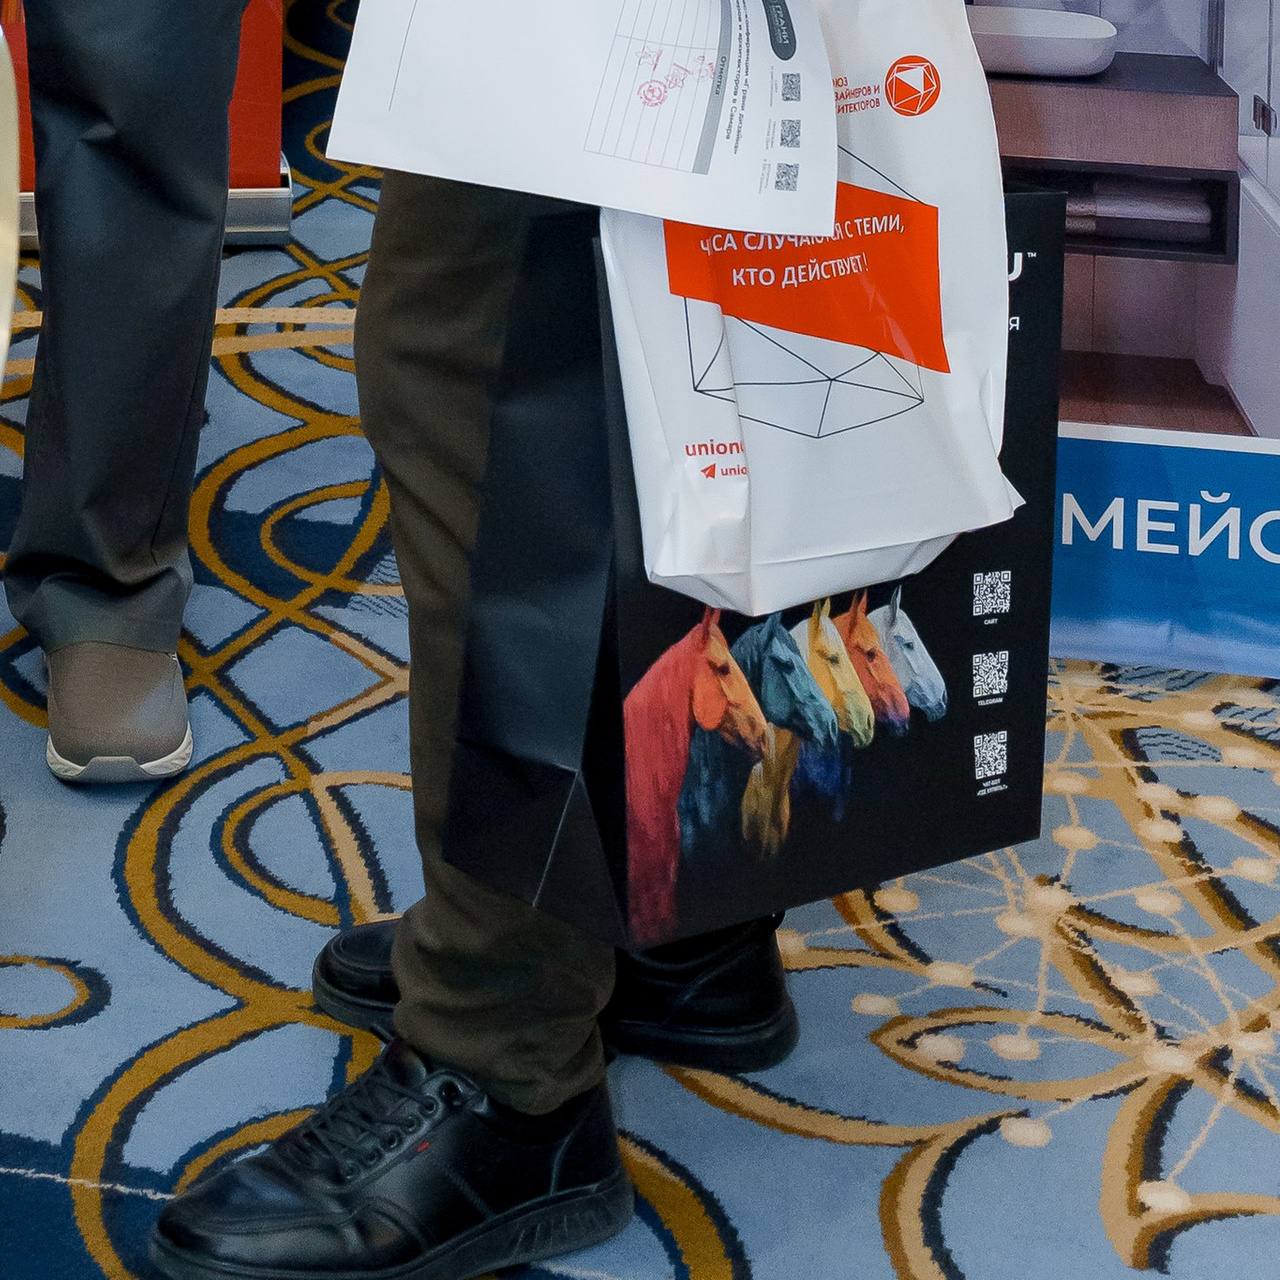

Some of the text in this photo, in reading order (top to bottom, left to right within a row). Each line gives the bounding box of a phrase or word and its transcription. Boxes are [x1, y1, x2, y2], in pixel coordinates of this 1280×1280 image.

[854, 214, 905, 237] ТЕМИ,
[732, 267, 776, 286] КТО
[977, 697, 1003, 706] TELEGRAM
